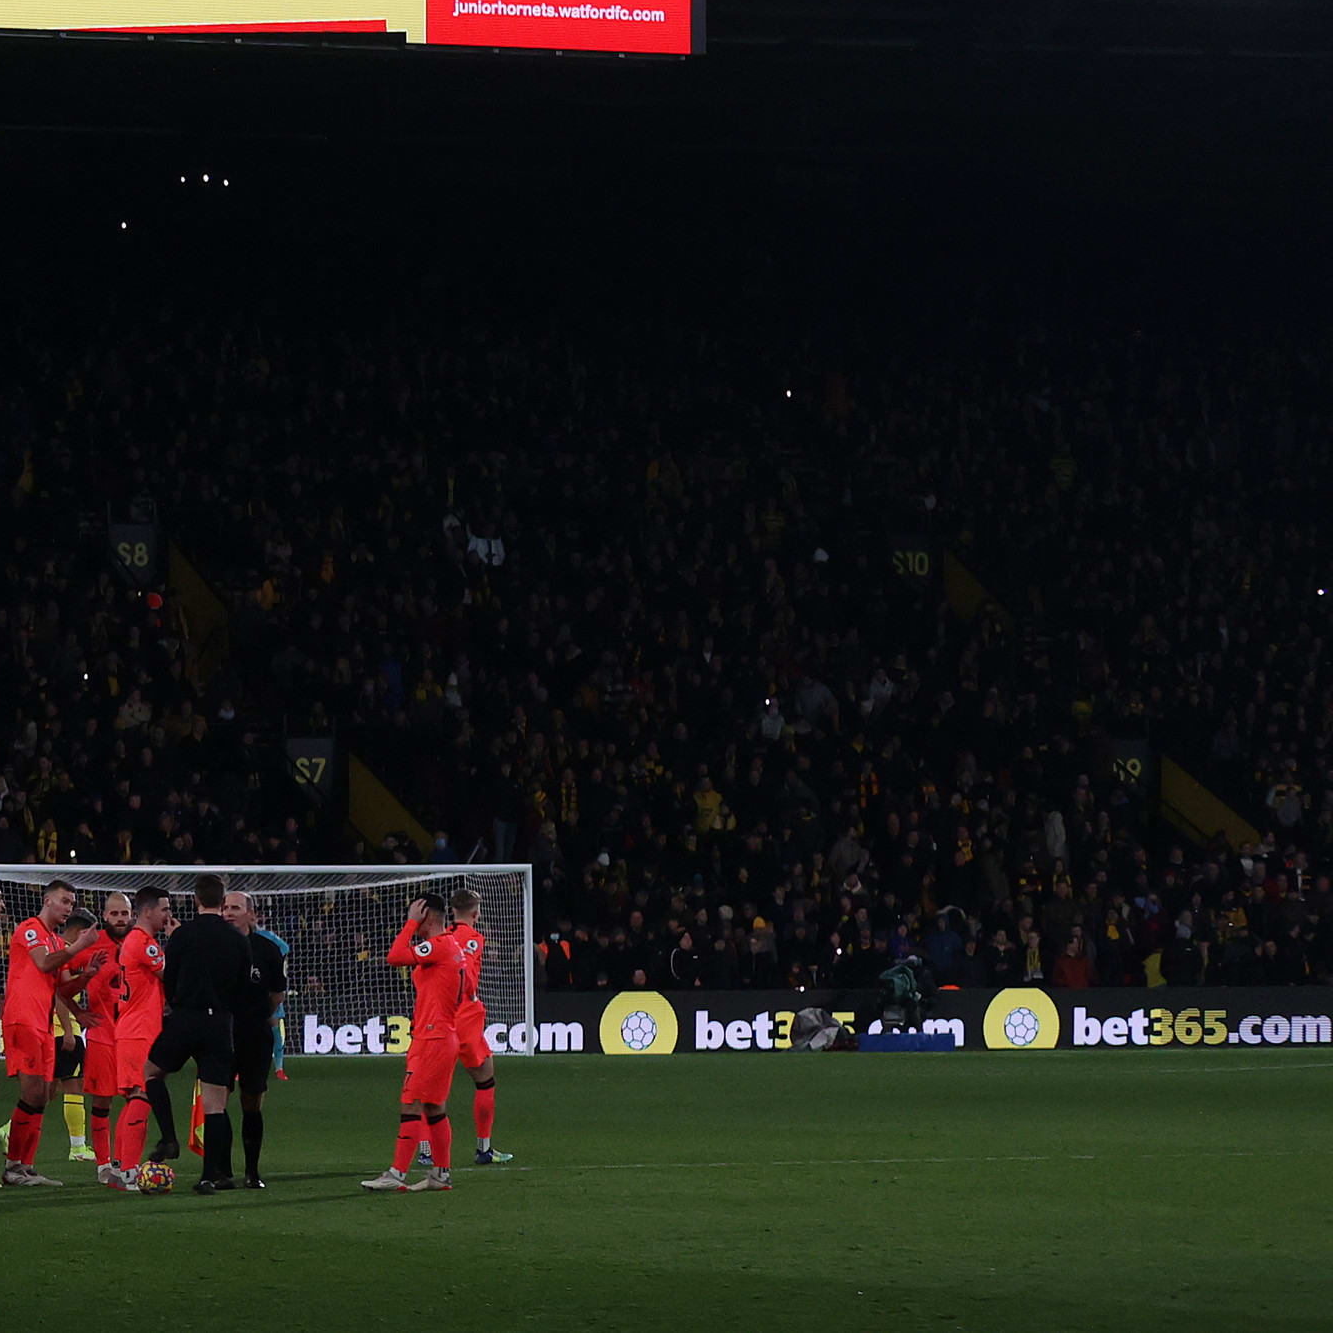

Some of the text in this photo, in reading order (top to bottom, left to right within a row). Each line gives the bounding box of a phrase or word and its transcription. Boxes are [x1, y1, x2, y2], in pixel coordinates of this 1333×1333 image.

[117, 541, 149, 567] S8
[294, 757, 326, 784] S7
[1073, 1006, 1333, 1047] bet365.com
